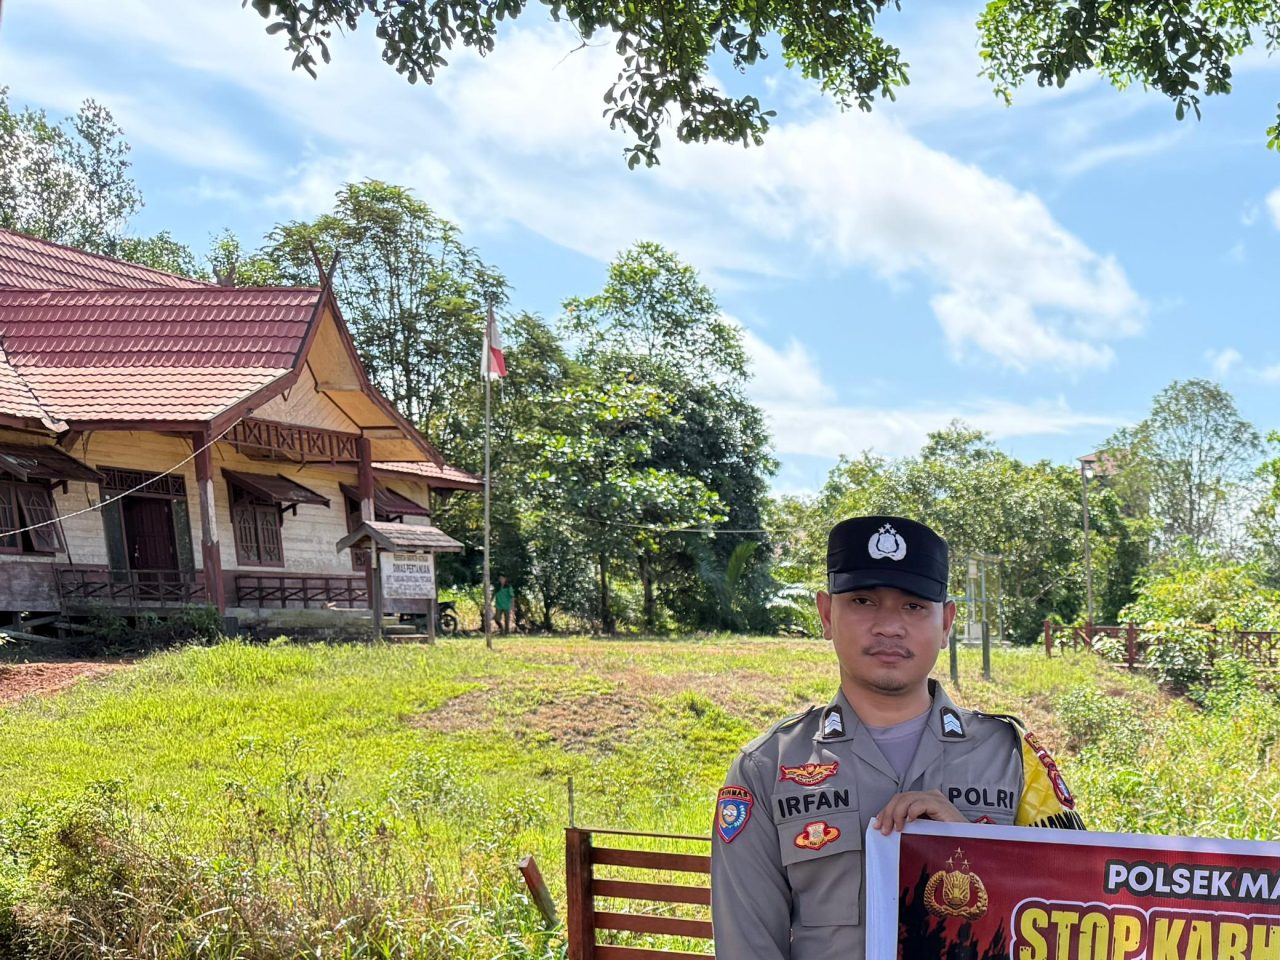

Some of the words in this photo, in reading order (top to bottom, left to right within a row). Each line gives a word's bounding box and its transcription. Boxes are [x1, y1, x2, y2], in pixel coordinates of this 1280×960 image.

[778, 789, 849, 818] IRFAN
[949, 787, 1014, 809] POLRI
[1108, 864, 1231, 897] POLSEK
